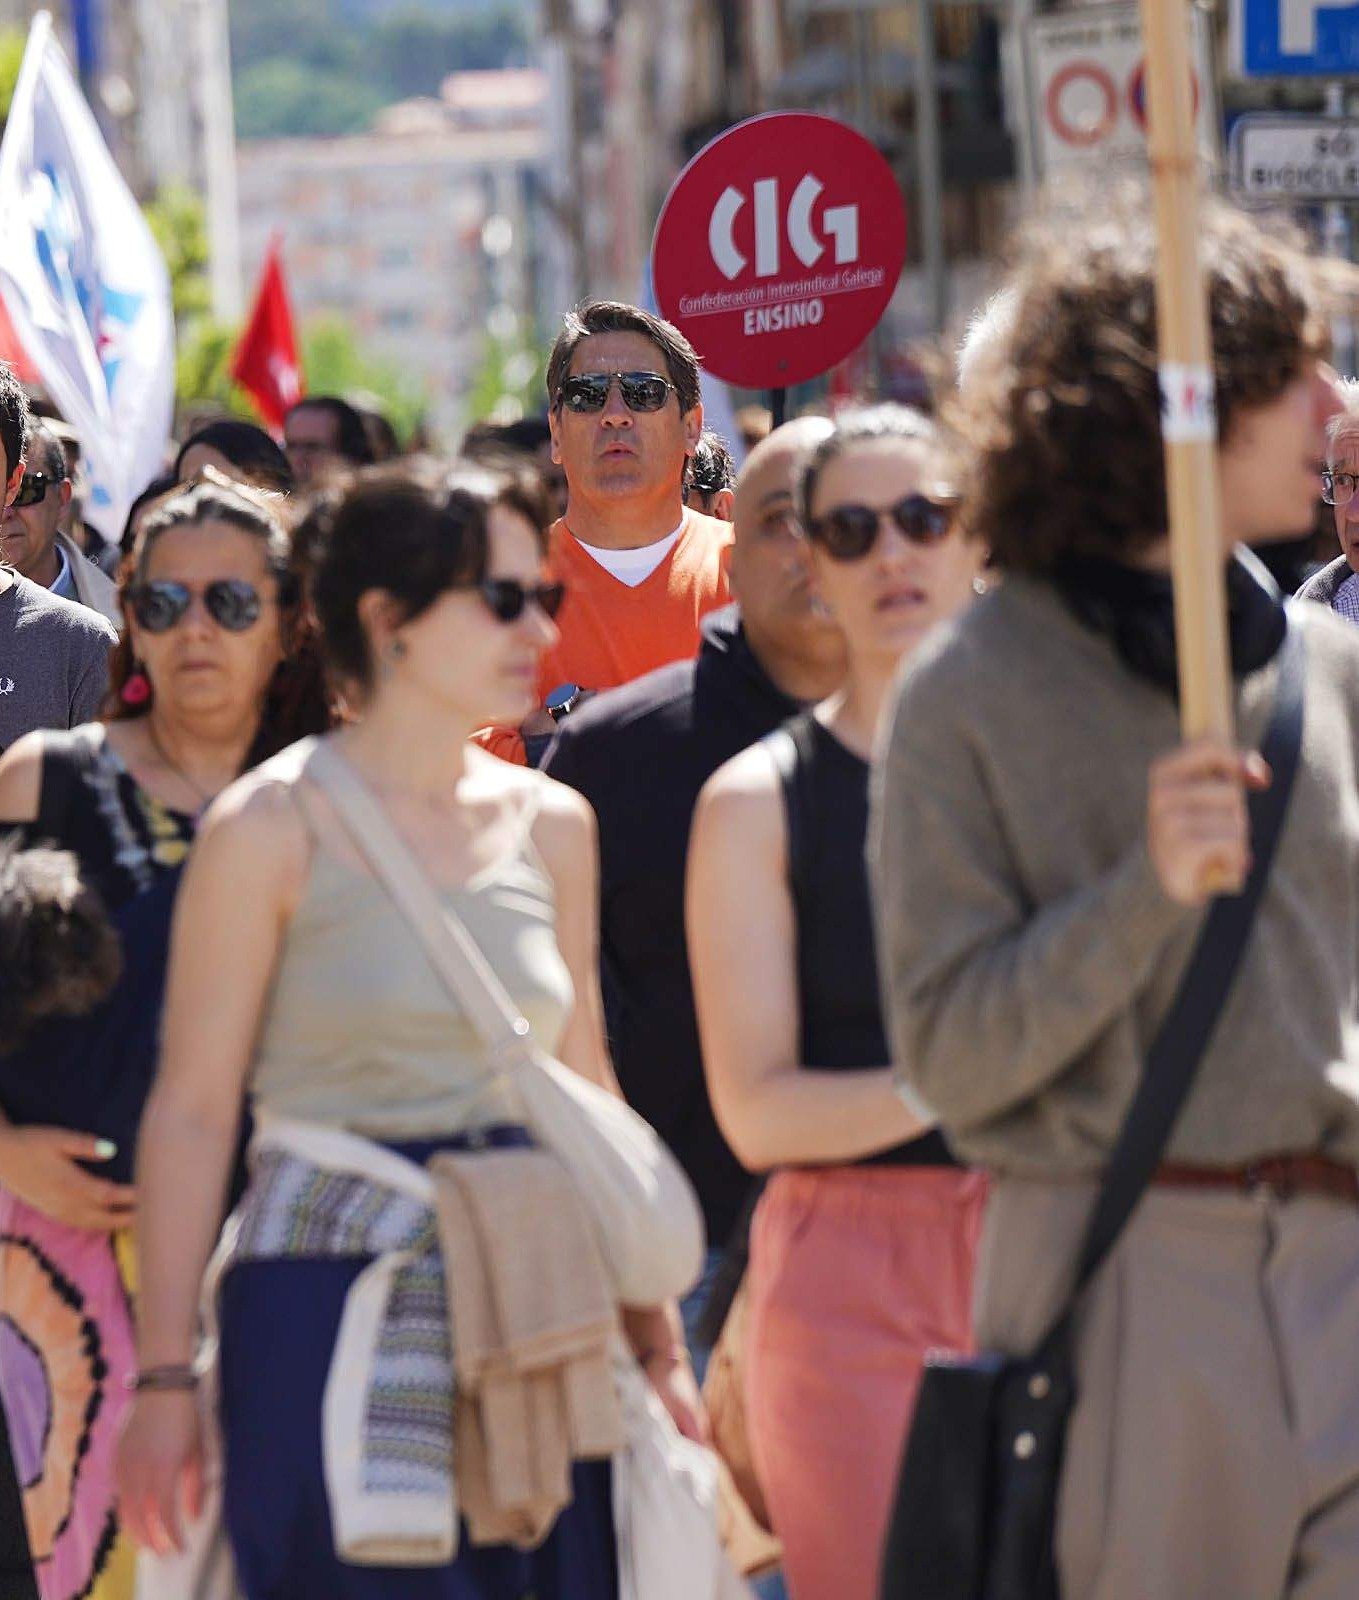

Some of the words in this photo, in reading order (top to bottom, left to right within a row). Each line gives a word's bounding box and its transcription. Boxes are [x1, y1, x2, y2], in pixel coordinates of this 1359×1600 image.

[709, 172, 859, 281] CIG
[679, 285, 764, 314] Confederación
[766, 271, 839, 300] Intersindical
[841, 266, 884, 287] Galega
[743, 299, 824, 335] ENSINO
